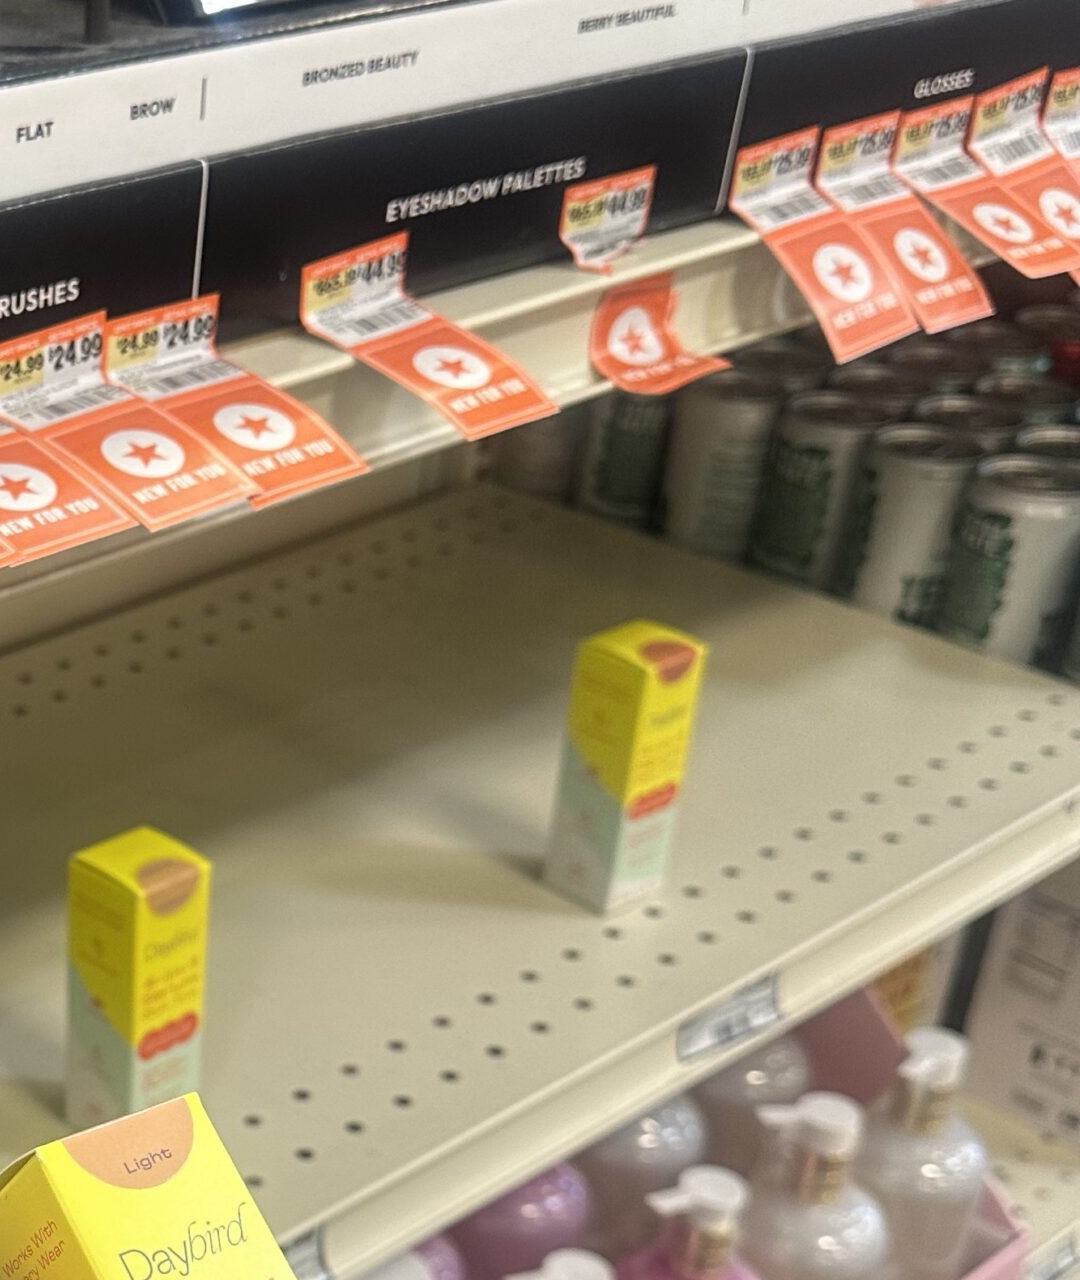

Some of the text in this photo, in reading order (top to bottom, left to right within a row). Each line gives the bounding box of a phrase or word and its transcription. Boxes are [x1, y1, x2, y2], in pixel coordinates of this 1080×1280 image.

[302, 50, 418, 86] BRONZED BEAUTY
[130, 97, 175, 121] BROW
[16, 122, 54, 143] FLAT
[386, 156, 587, 224] EYESHADOW PALETTES
[48, 332, 103, 371] $24.99
[241, 438, 335, 478] NEW FOR YOU
[134, 462, 227, 505] NEW FOR YOU
[34, 506, 68, 528] FOR
[68, 495, 100, 519] YOU
[123, 1146, 172, 1175] Light
[3, 1220, 58, 1278] Works With
[39, 1240, 66, 1270] Wear
